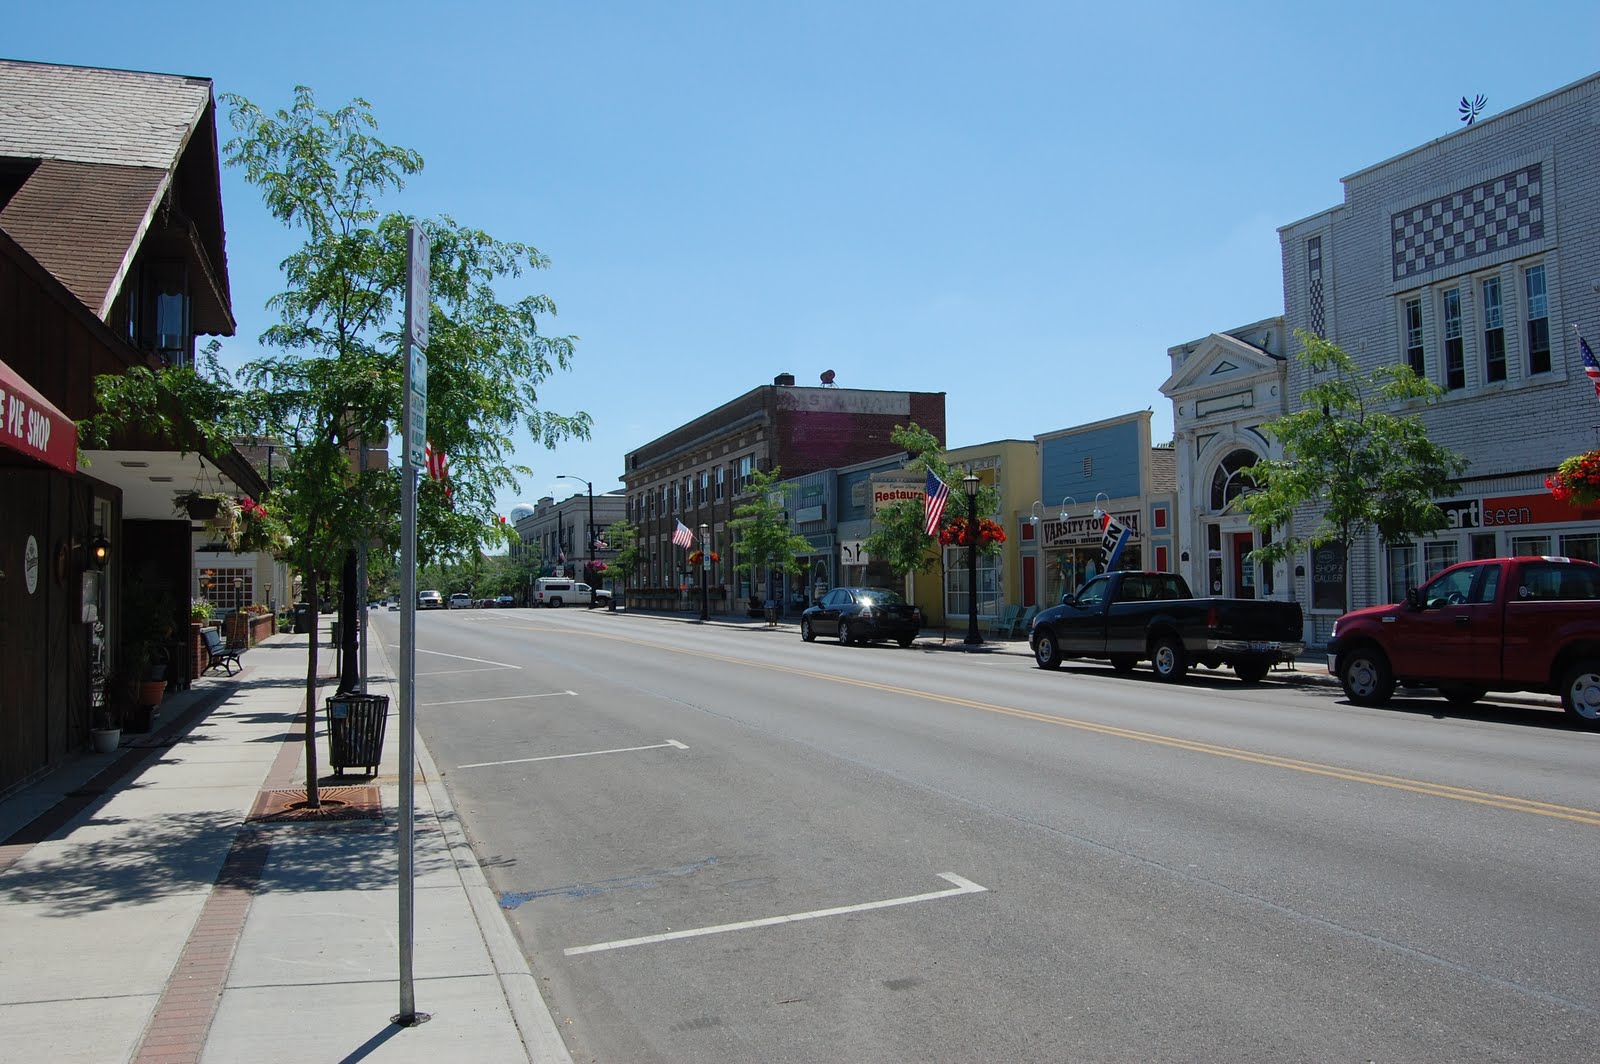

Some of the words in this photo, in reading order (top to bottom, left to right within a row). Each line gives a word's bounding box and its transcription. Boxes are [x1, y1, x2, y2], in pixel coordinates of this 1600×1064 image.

[8, 394, 25, 438] PIE
[27, 407, 51, 452] SHOP
[1446, 501, 1479, 528] art
[1484, 507, 1531, 526] seen
[1044, 520, 1084, 543] VARSITY
[1314, 574, 1343, 583] GALLER
[1315, 564, 1337, 573] SHOP
